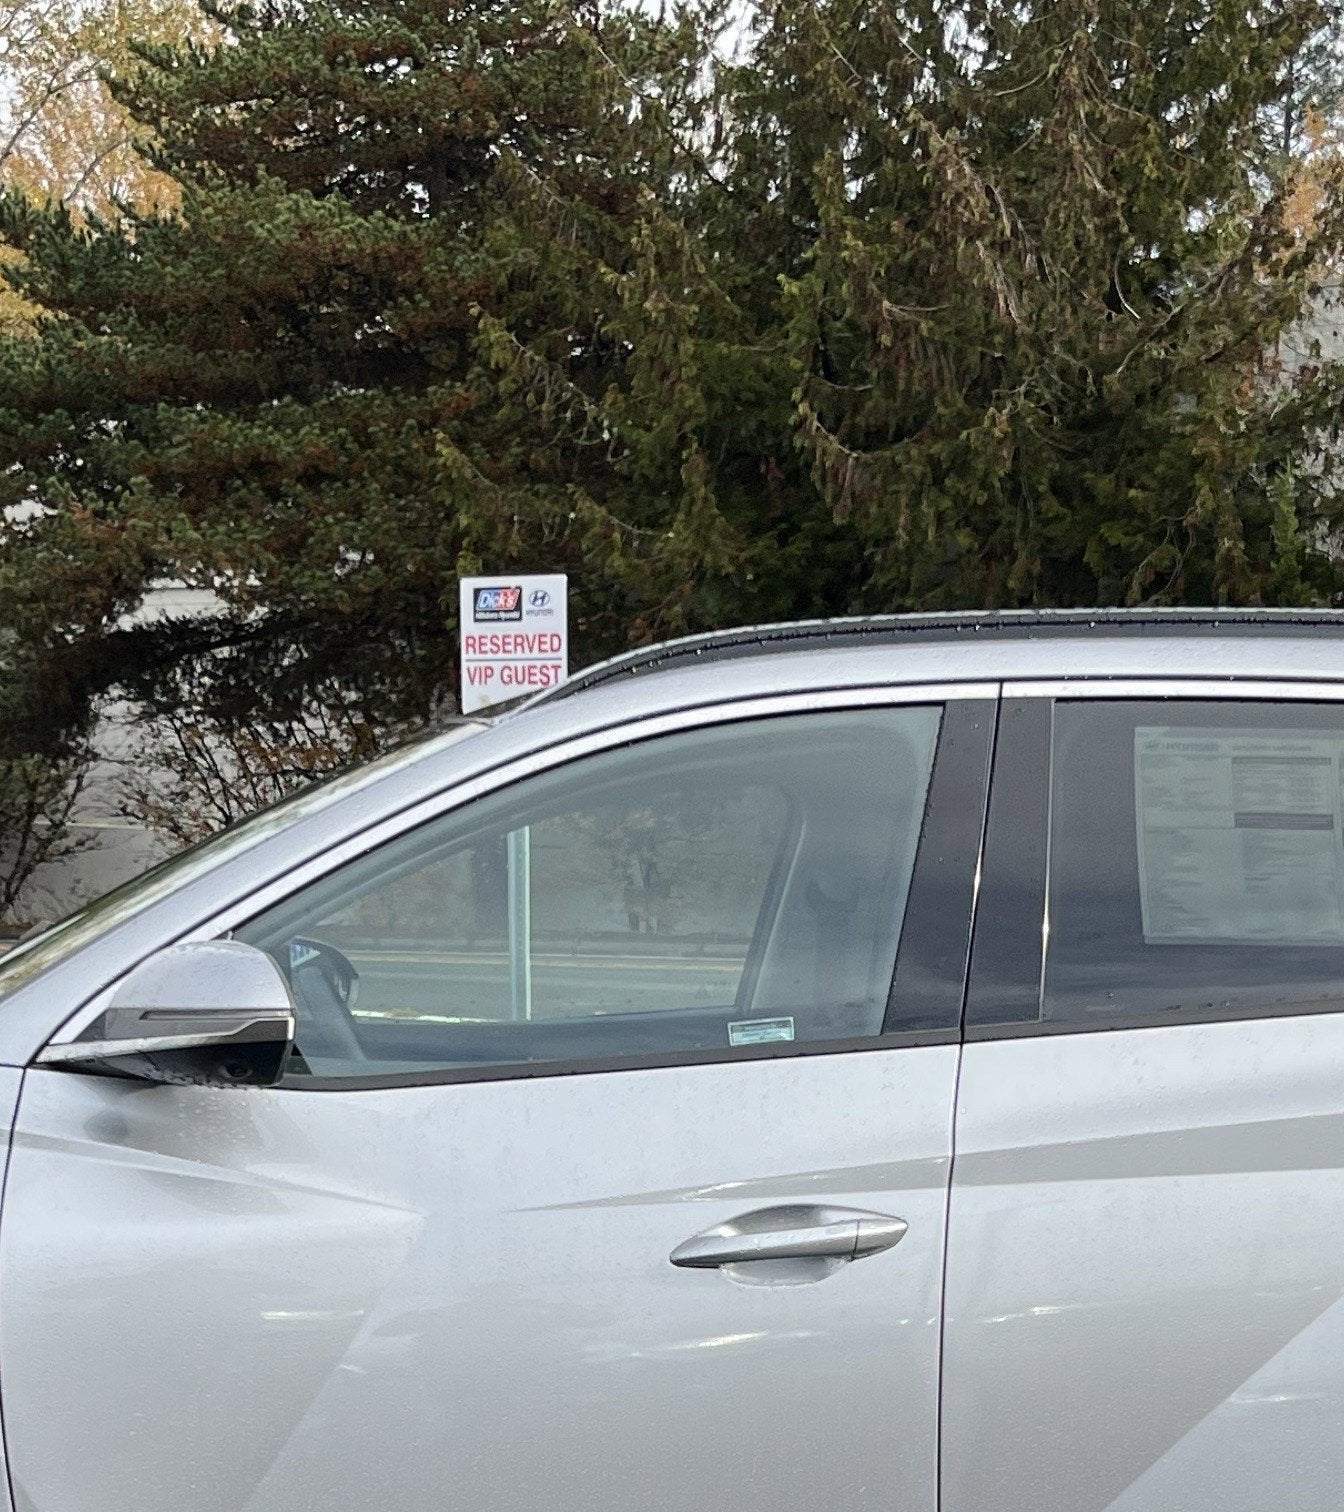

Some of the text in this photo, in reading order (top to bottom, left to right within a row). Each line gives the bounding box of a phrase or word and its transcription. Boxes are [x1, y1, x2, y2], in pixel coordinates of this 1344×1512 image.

[465, 633, 562, 655] RESERVED
[467, 664, 562, 686] VIP GUEST
